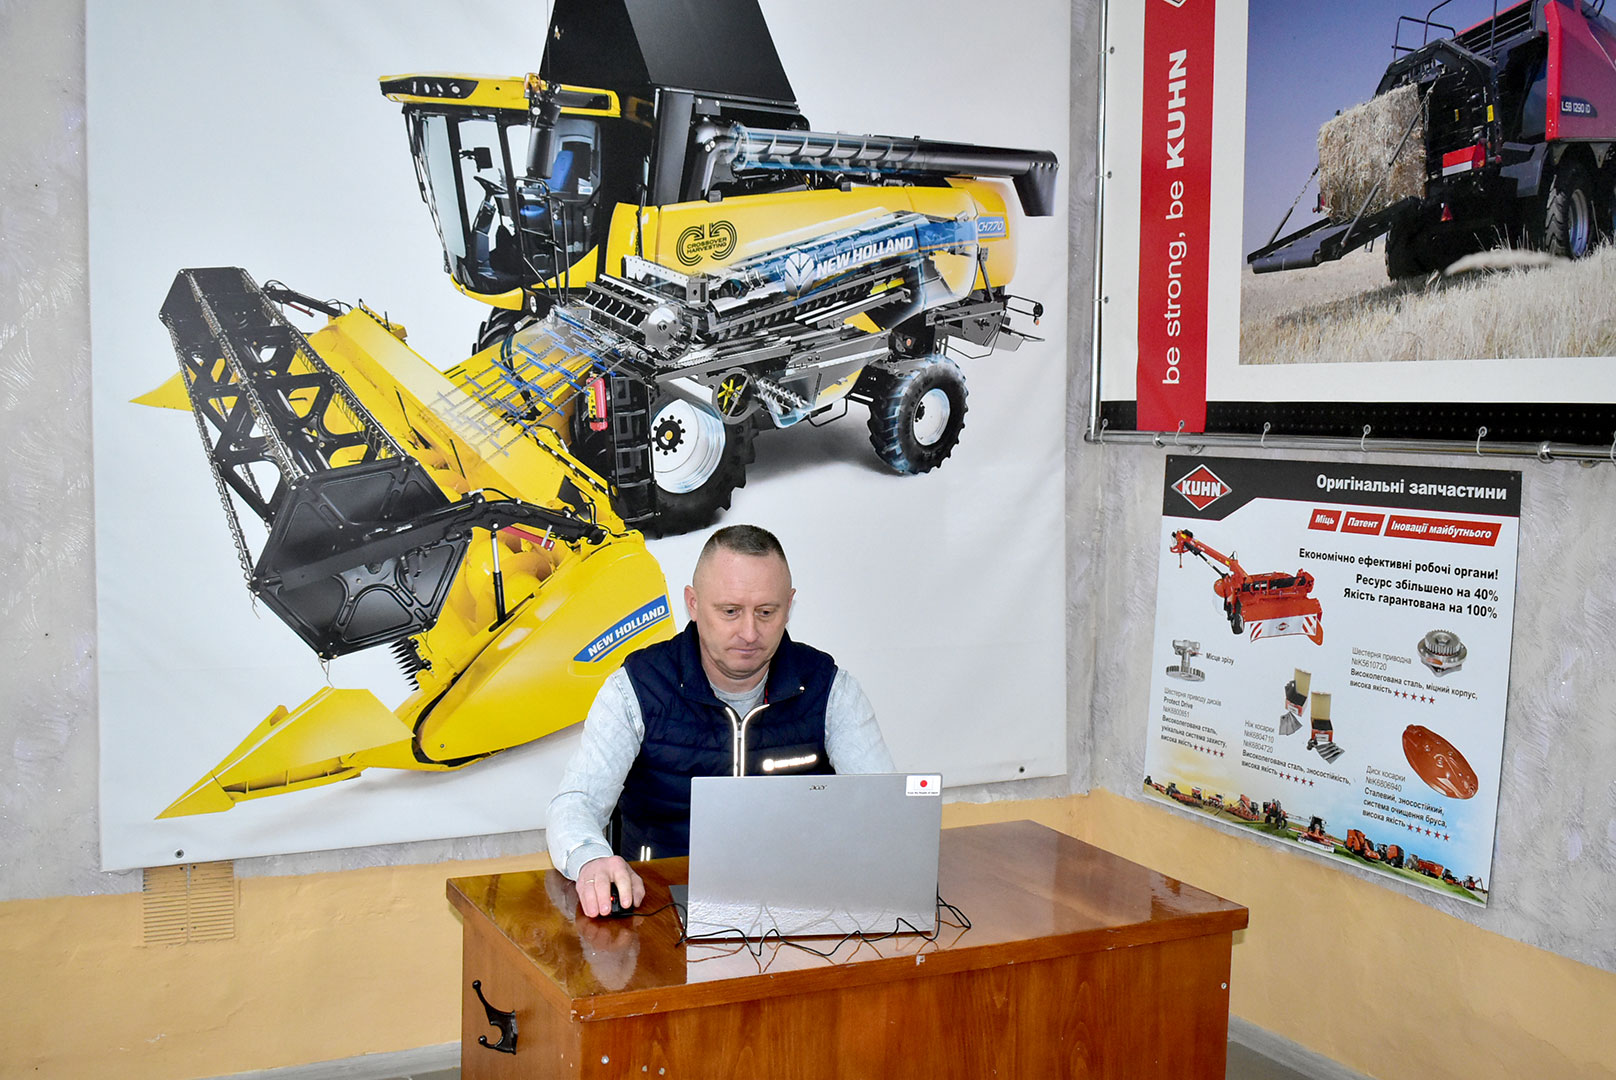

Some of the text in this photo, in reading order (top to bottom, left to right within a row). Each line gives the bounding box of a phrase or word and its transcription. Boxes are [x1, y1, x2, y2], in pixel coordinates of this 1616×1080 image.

[1162, 49, 1187, 385] be strong, be KUHN
[687, 237, 728, 249] CROSSOVER
[687, 242, 727, 254] HARVESTING
[816, 236, 914, 278] NEW HOLLAND
[1182, 480, 1221, 497] KUHN
[1316, 474, 1507, 500] Оригінальні запчастини
[1315, 514, 1335, 526] Міць
[1347, 517, 1379, 529] Патент
[1391, 520, 1492, 539] Іновації майбутнього
[1299, 548, 1499, 580] Економічно ефективні робочі органи!
[1356, 574, 1499, 602] Ресурс збільшено на 40%
[1344, 588, 1498, 619] Якість гарантована на 100%
[587, 605, 666, 657] NEW HOLLAND
[1350, 668, 1478, 700] Високолегована сталь, міцний корпус,
[1350, 680, 1392, 694] висока якість
[1241, 760, 1278, 776] висока якість
[1242, 749, 1287, 768] Високолегована
[1364, 786, 1445, 816] Сталевий, зносостійкий,
[1362, 810, 1406, 827] висока якість
[1363, 800, 1448, 828] система очищення бруса,
